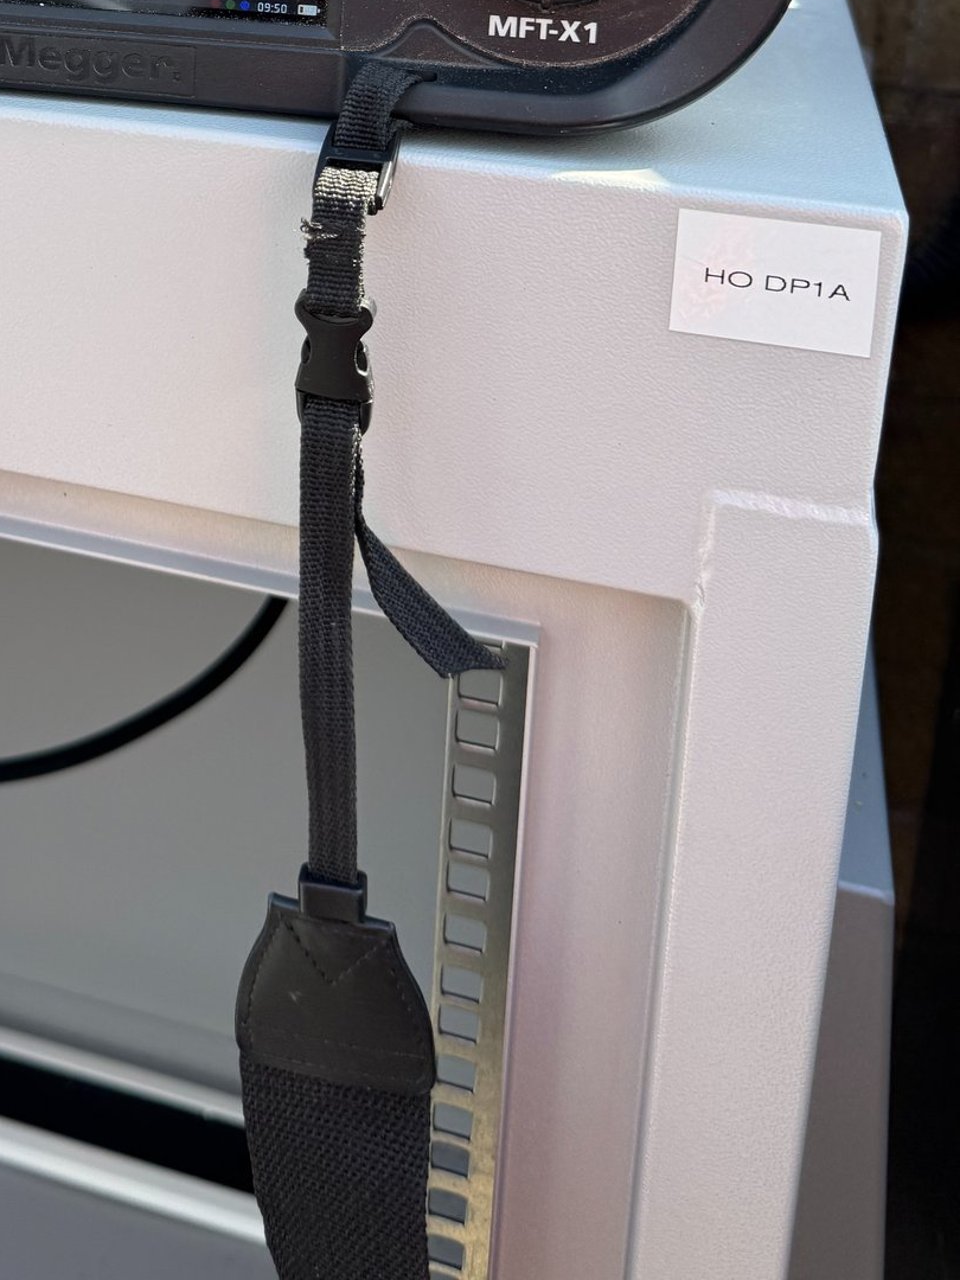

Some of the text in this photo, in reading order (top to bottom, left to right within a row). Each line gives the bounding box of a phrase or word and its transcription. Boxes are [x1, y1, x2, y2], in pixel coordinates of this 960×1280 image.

[256, 1, 289, 15] 09:50
[487, 14, 598, 45] MFT-X1
[704, 267, 851, 301] HO DP1A
